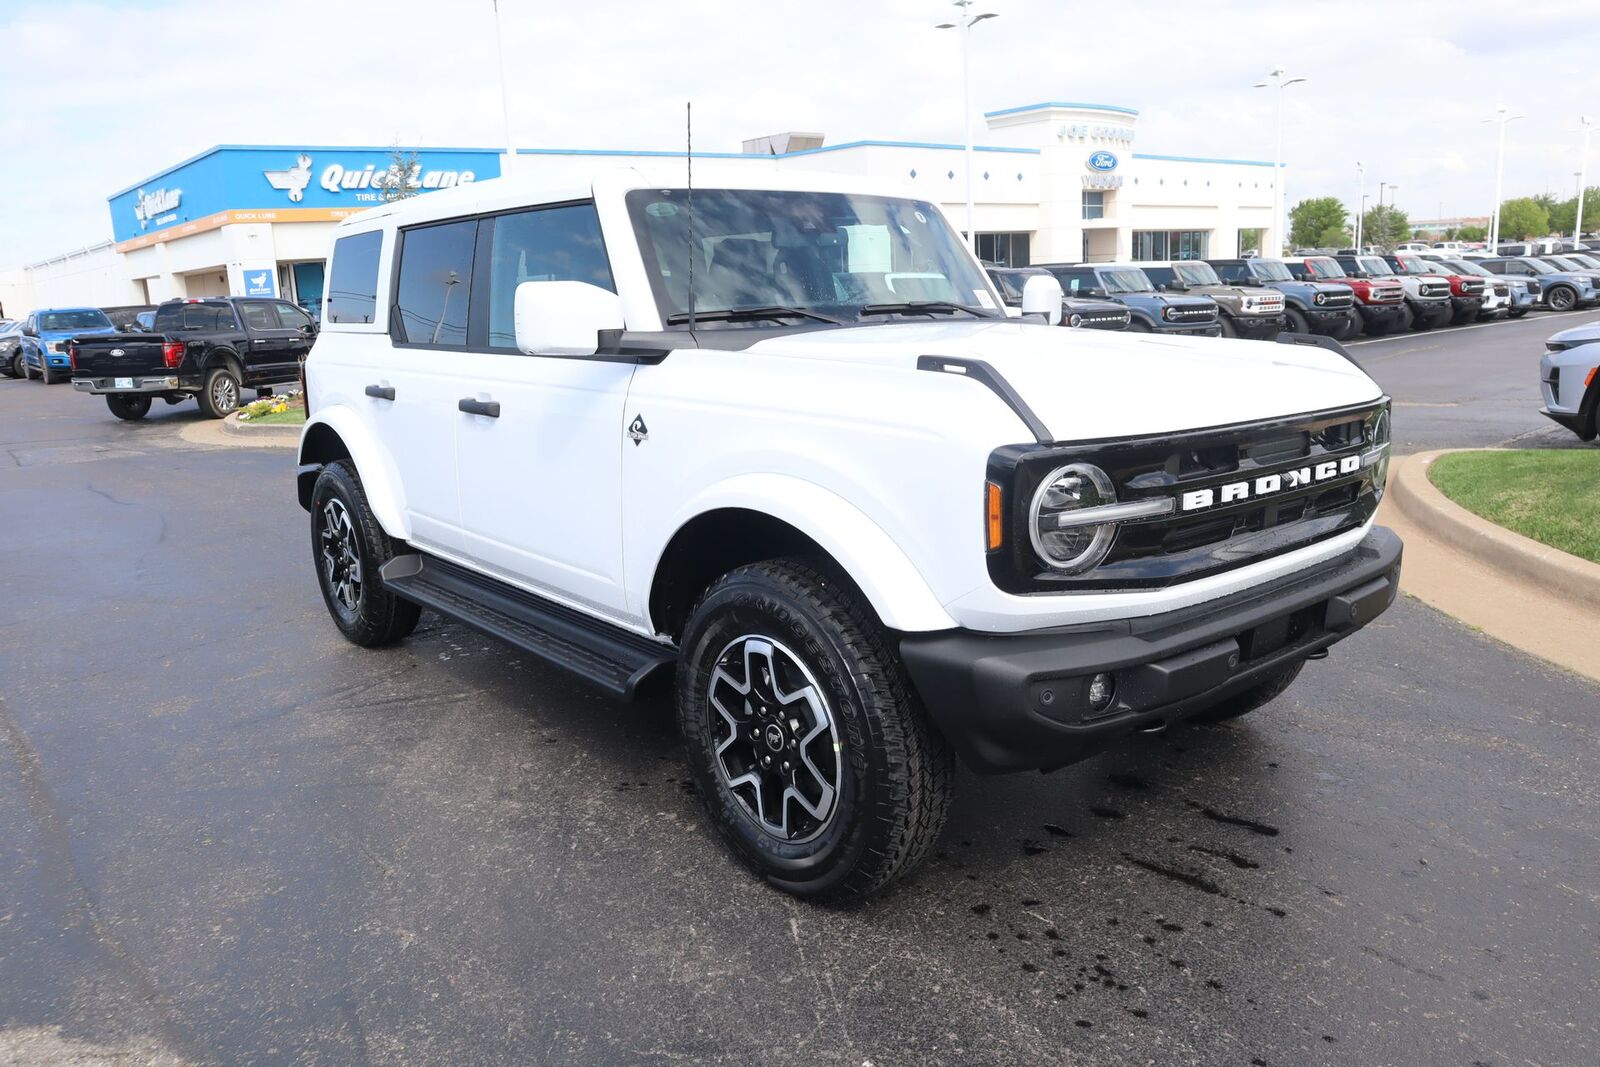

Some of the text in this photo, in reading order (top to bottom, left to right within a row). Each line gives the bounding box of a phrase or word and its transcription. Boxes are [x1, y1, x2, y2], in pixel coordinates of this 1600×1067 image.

[320, 164, 475, 193] Quick Lane
[356, 193, 377, 201] TIRE
[1182, 455, 1360, 511] BRONCO
